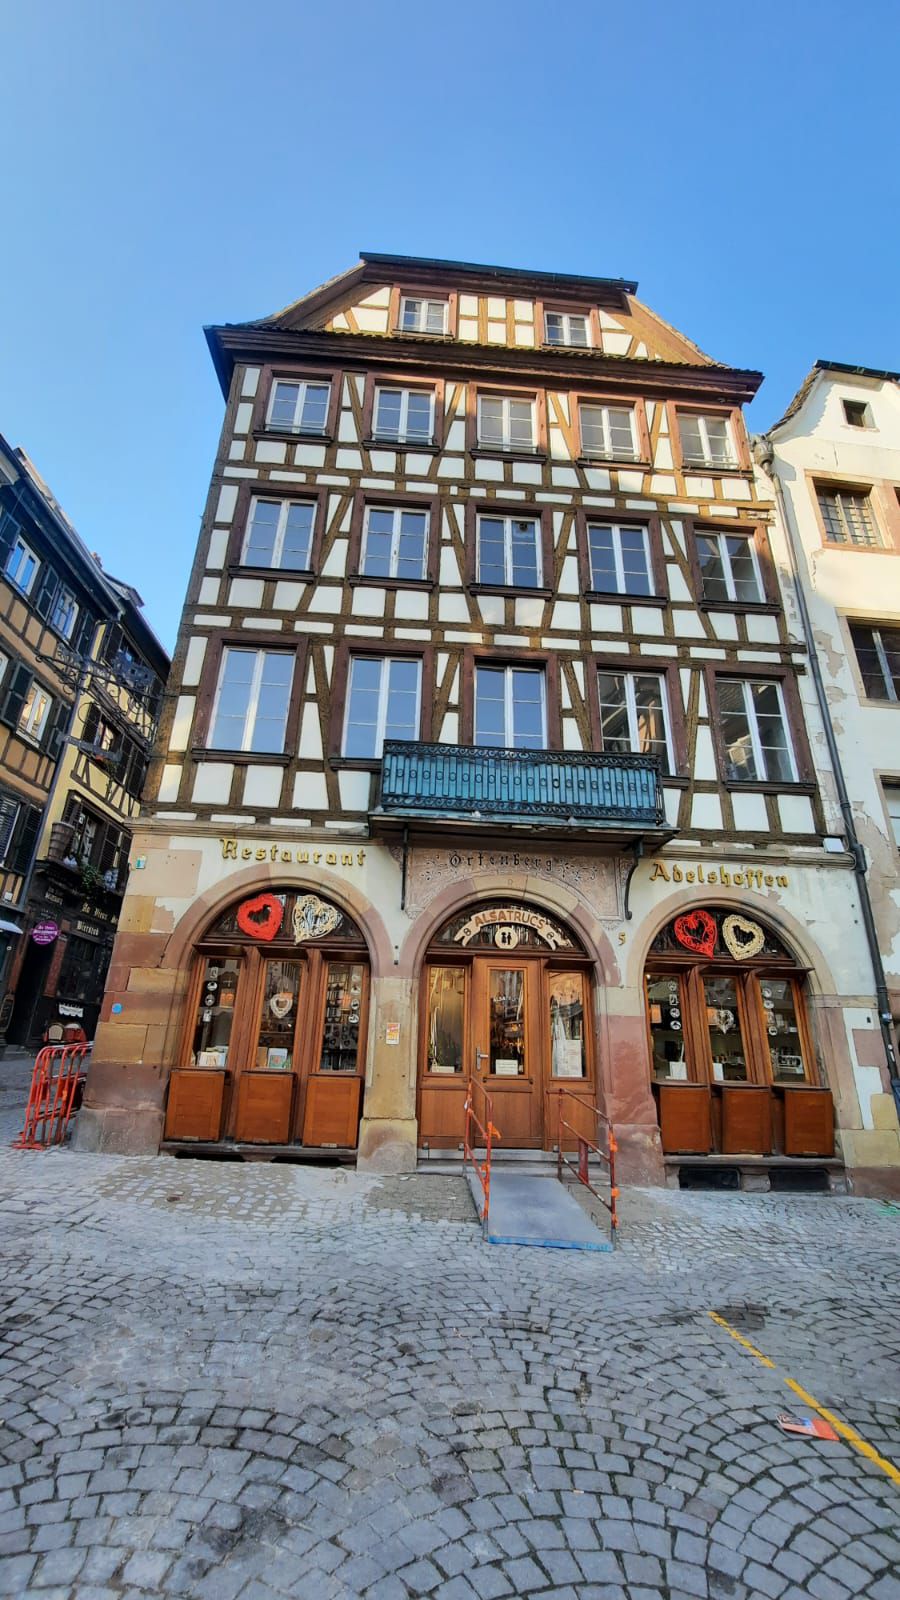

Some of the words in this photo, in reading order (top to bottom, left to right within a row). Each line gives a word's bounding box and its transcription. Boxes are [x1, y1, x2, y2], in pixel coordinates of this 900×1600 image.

[220, 837, 366, 865] Restaurant
[650, 860, 789, 888] Adelshoffen
[474, 910, 546, 930] ALSATRUCS
[618, 931, 626, 946] 5
